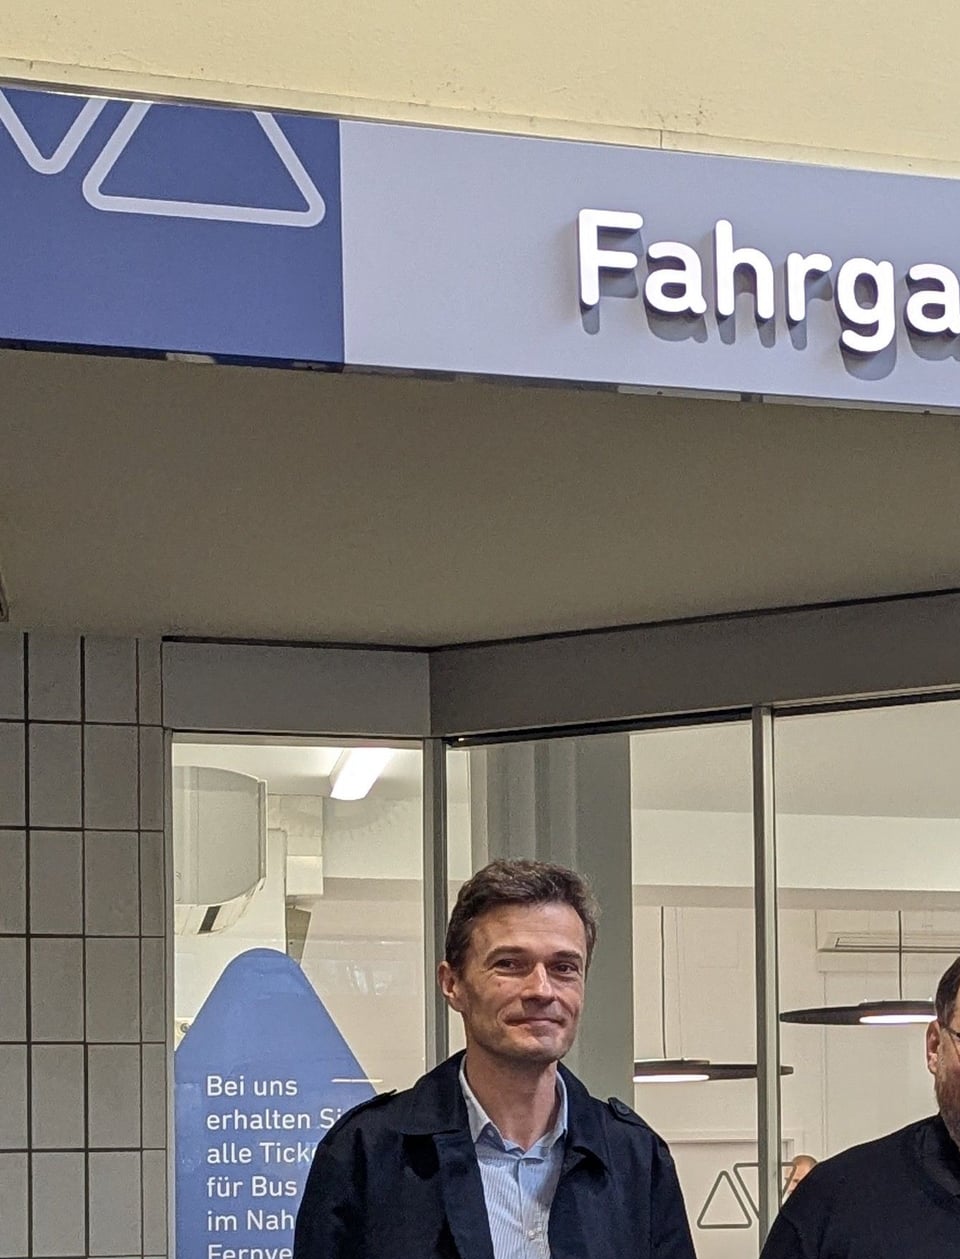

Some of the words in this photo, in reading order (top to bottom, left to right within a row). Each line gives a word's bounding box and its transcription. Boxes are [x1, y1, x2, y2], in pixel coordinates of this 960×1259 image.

[206, 1075, 245, 1096] Bei
[253, 1079, 298, 1096] uns
[206, 1109, 311, 1130] erhalten
[319, 1108, 342, 1129] Si
[207, 1142, 252, 1164] alle
[206, 1177, 243, 1197] für
[251, 1176, 298, 1197] Bus
[207, 1210, 237, 1231] im
[247, 1210, 294, 1231] Nah
